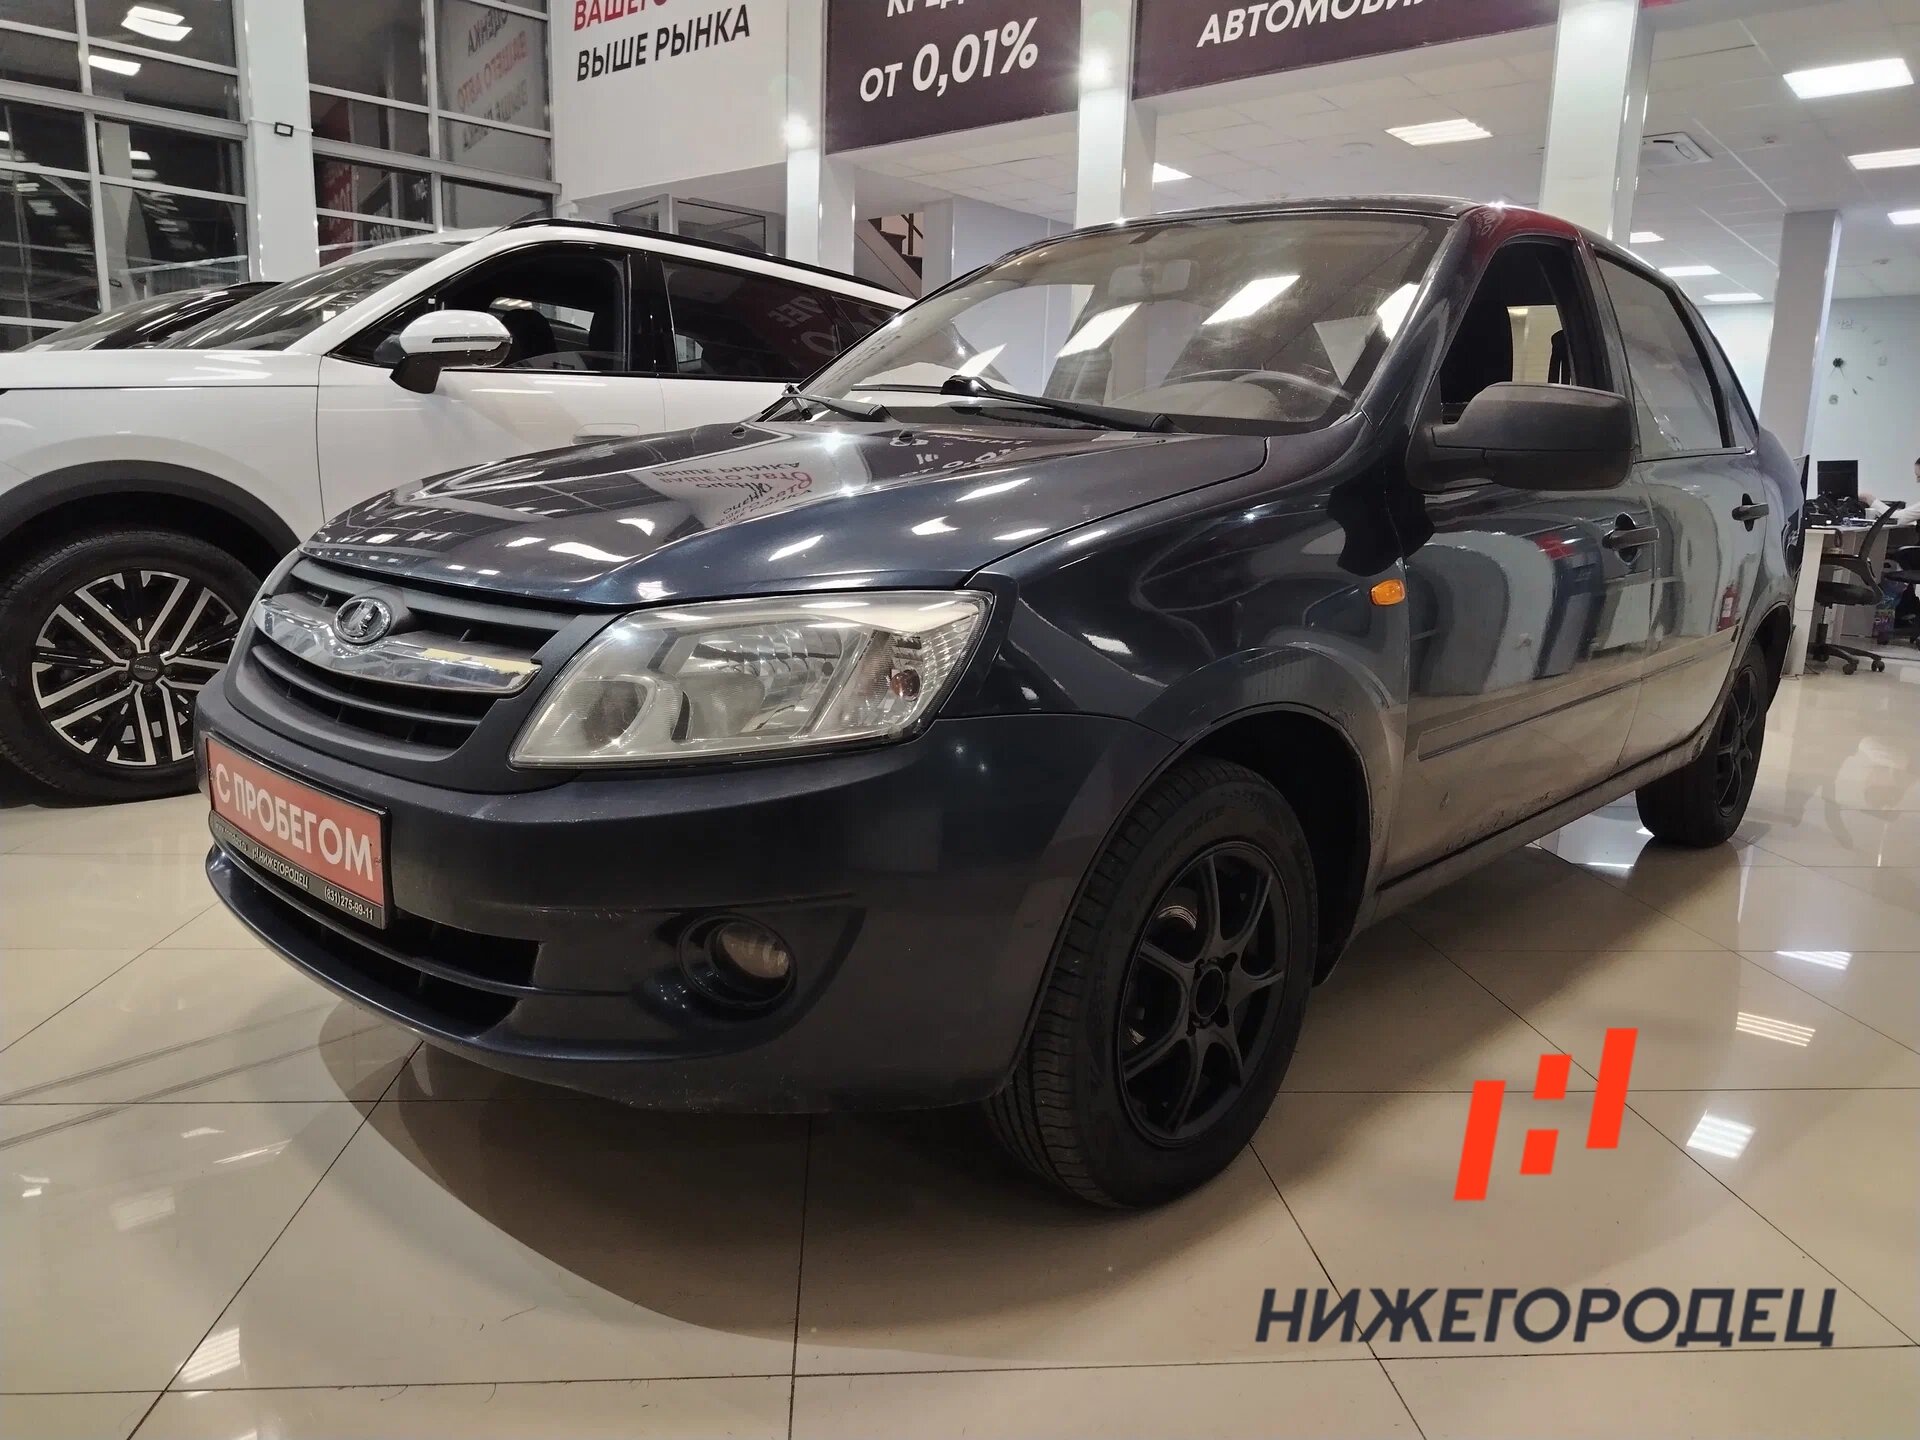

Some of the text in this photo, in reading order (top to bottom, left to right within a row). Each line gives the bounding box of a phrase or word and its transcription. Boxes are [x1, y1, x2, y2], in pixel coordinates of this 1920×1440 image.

[577, 4, 750, 82] ВЫШЕ РЫНКА
[912, 17, 1039, 97] 0,01%
[215, 763, 374, 882] С ПРОБЕГОМ
[259, 849, 309, 889] НИЖЕГОРОДЕЦ
